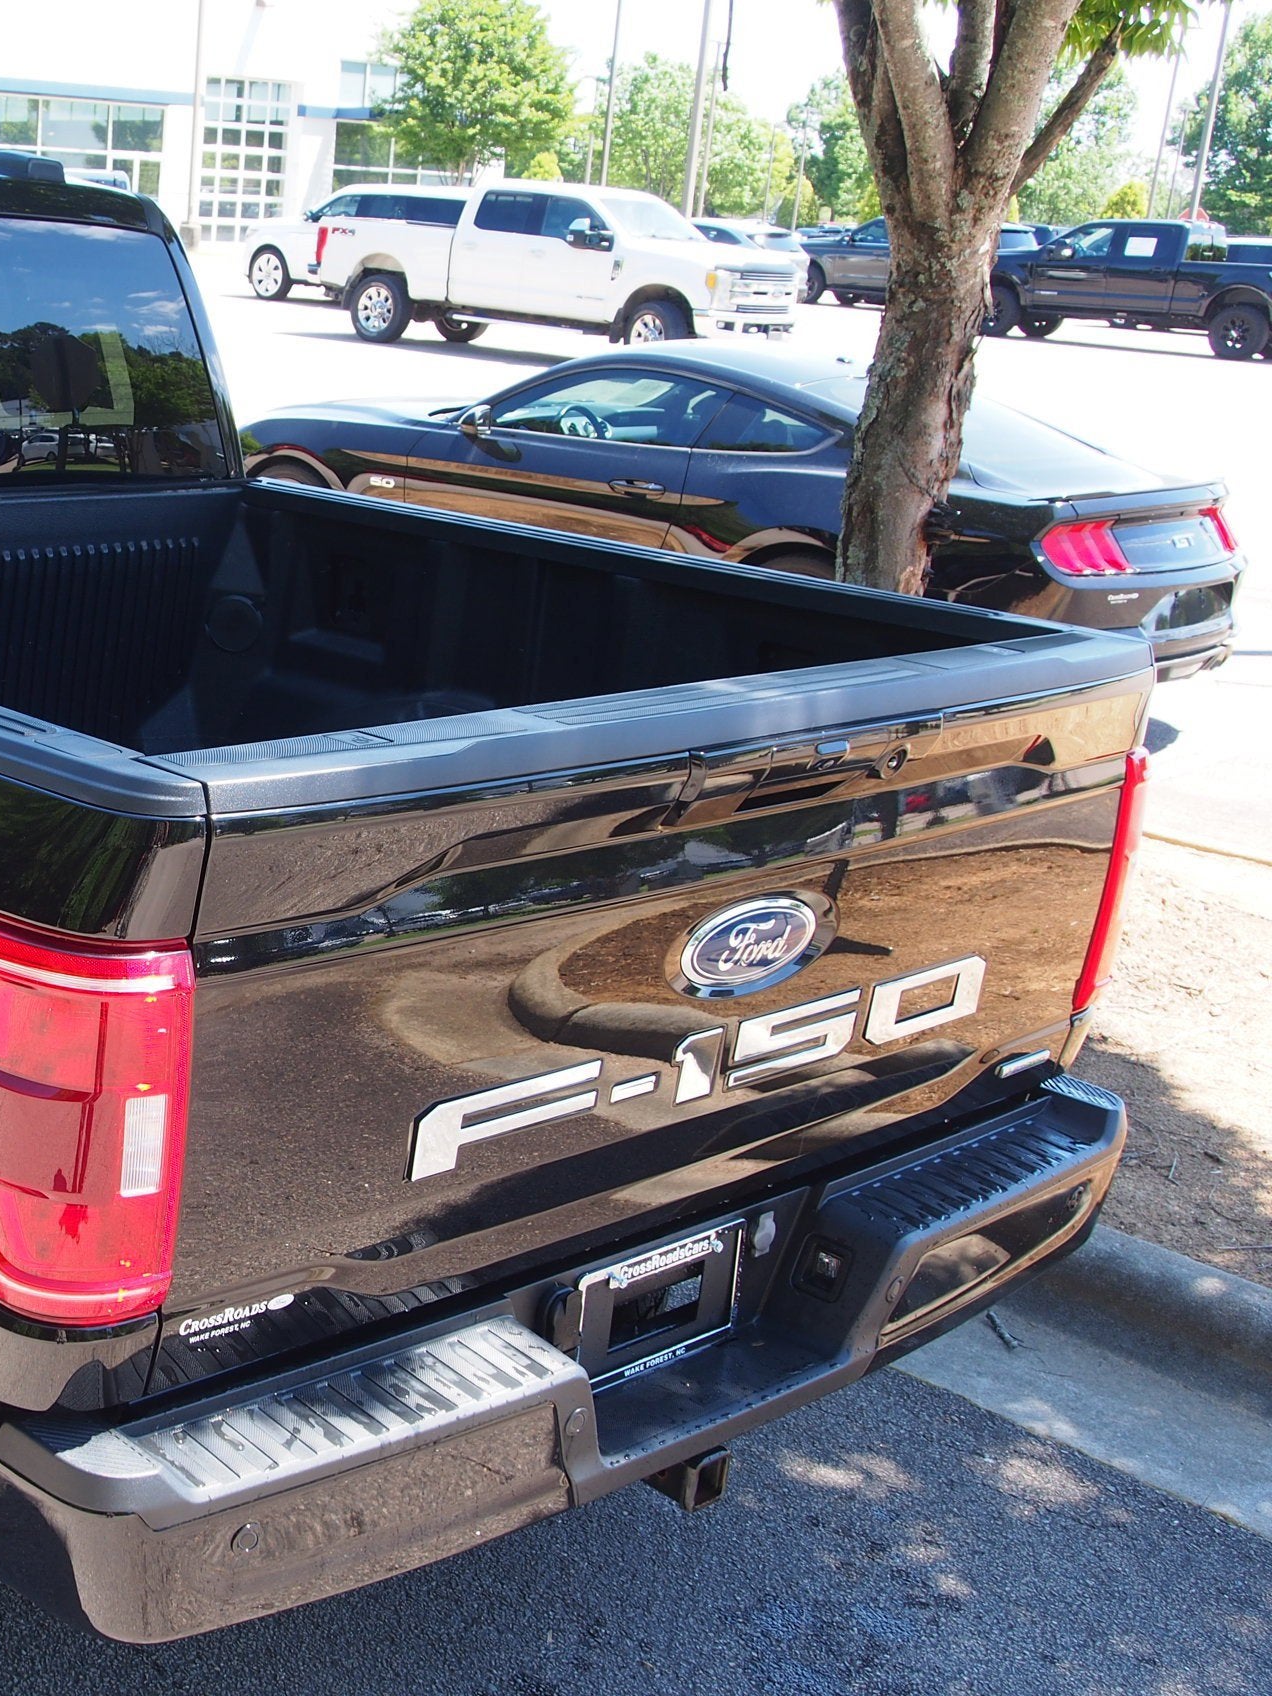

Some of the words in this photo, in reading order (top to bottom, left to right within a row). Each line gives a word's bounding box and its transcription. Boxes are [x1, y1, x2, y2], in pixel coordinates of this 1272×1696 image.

[1172, 533, 1195, 549] GT
[718, 918, 792, 972] Ford
[402, 953, 987, 1185] F-150
[189, 1331, 210, 1344] WAKE
[239, 1321, 251, 1330] NC
[624, 1363, 645, 1377] WAKE
[675, 1347, 686, 1357] NC
